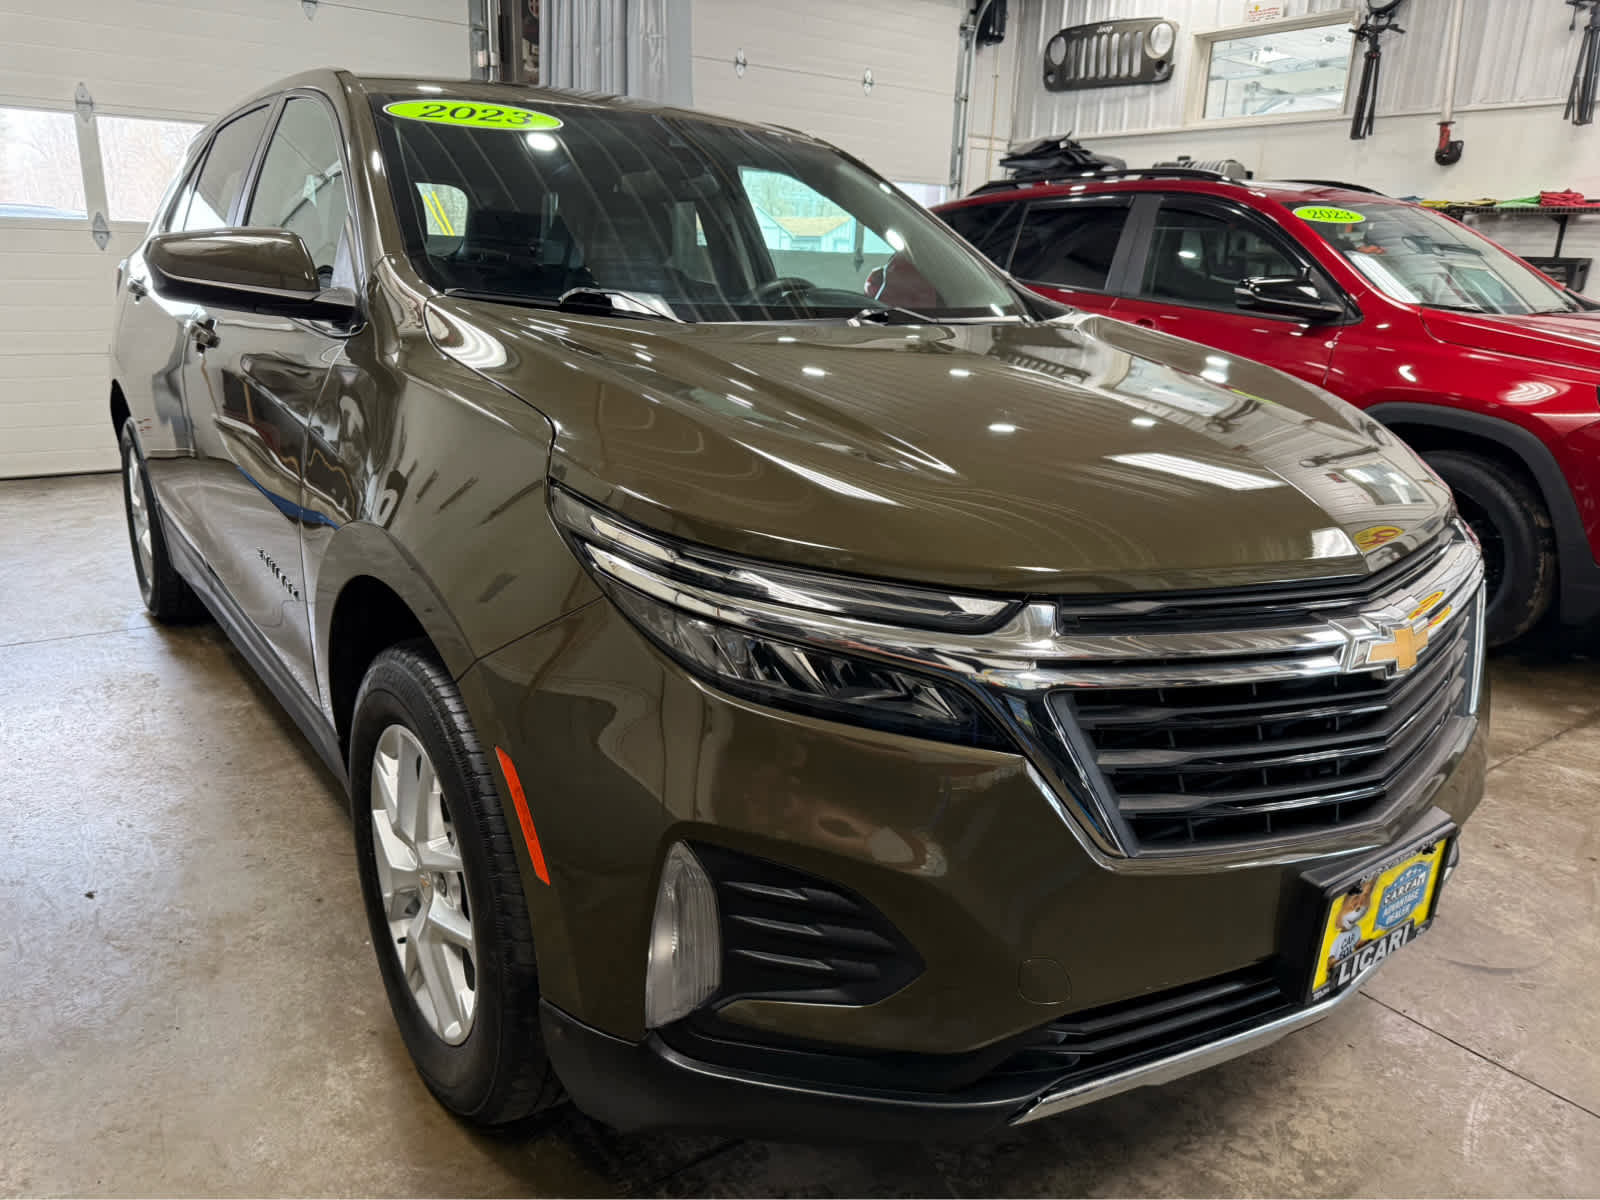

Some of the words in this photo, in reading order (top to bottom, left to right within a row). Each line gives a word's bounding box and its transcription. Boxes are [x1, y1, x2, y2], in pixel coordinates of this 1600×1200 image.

[418, 104, 533, 125] 2023
[1307, 209, 1353, 220] 2023
[1384, 871, 1426, 905] CARFAX
[1338, 923, 1410, 986] LICARI
